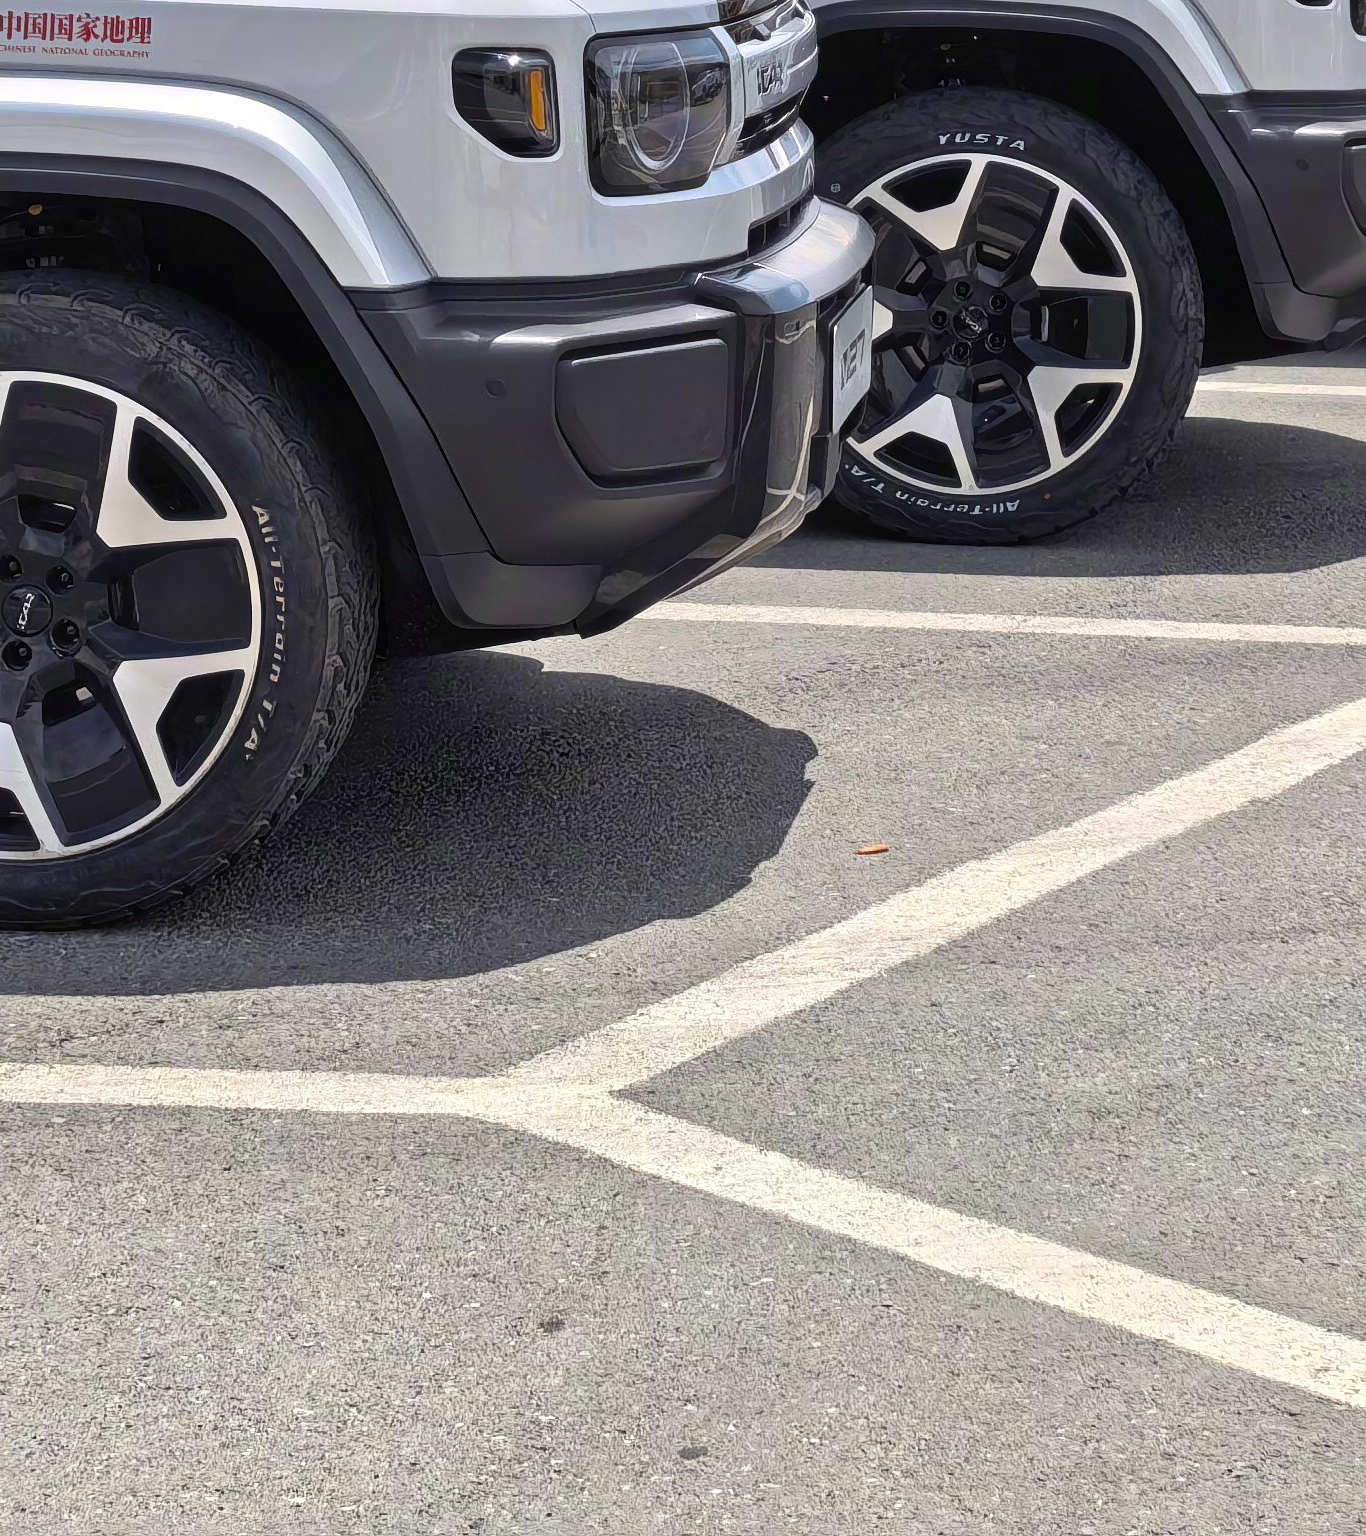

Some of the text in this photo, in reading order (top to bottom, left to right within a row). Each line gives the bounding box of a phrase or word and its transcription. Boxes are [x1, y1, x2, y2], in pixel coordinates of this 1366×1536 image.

[42, 46, 89, 56] NATIONAL
[92, 48, 151, 59] GEOGRAPHY
[939, 133, 1025, 150] YUSTA
